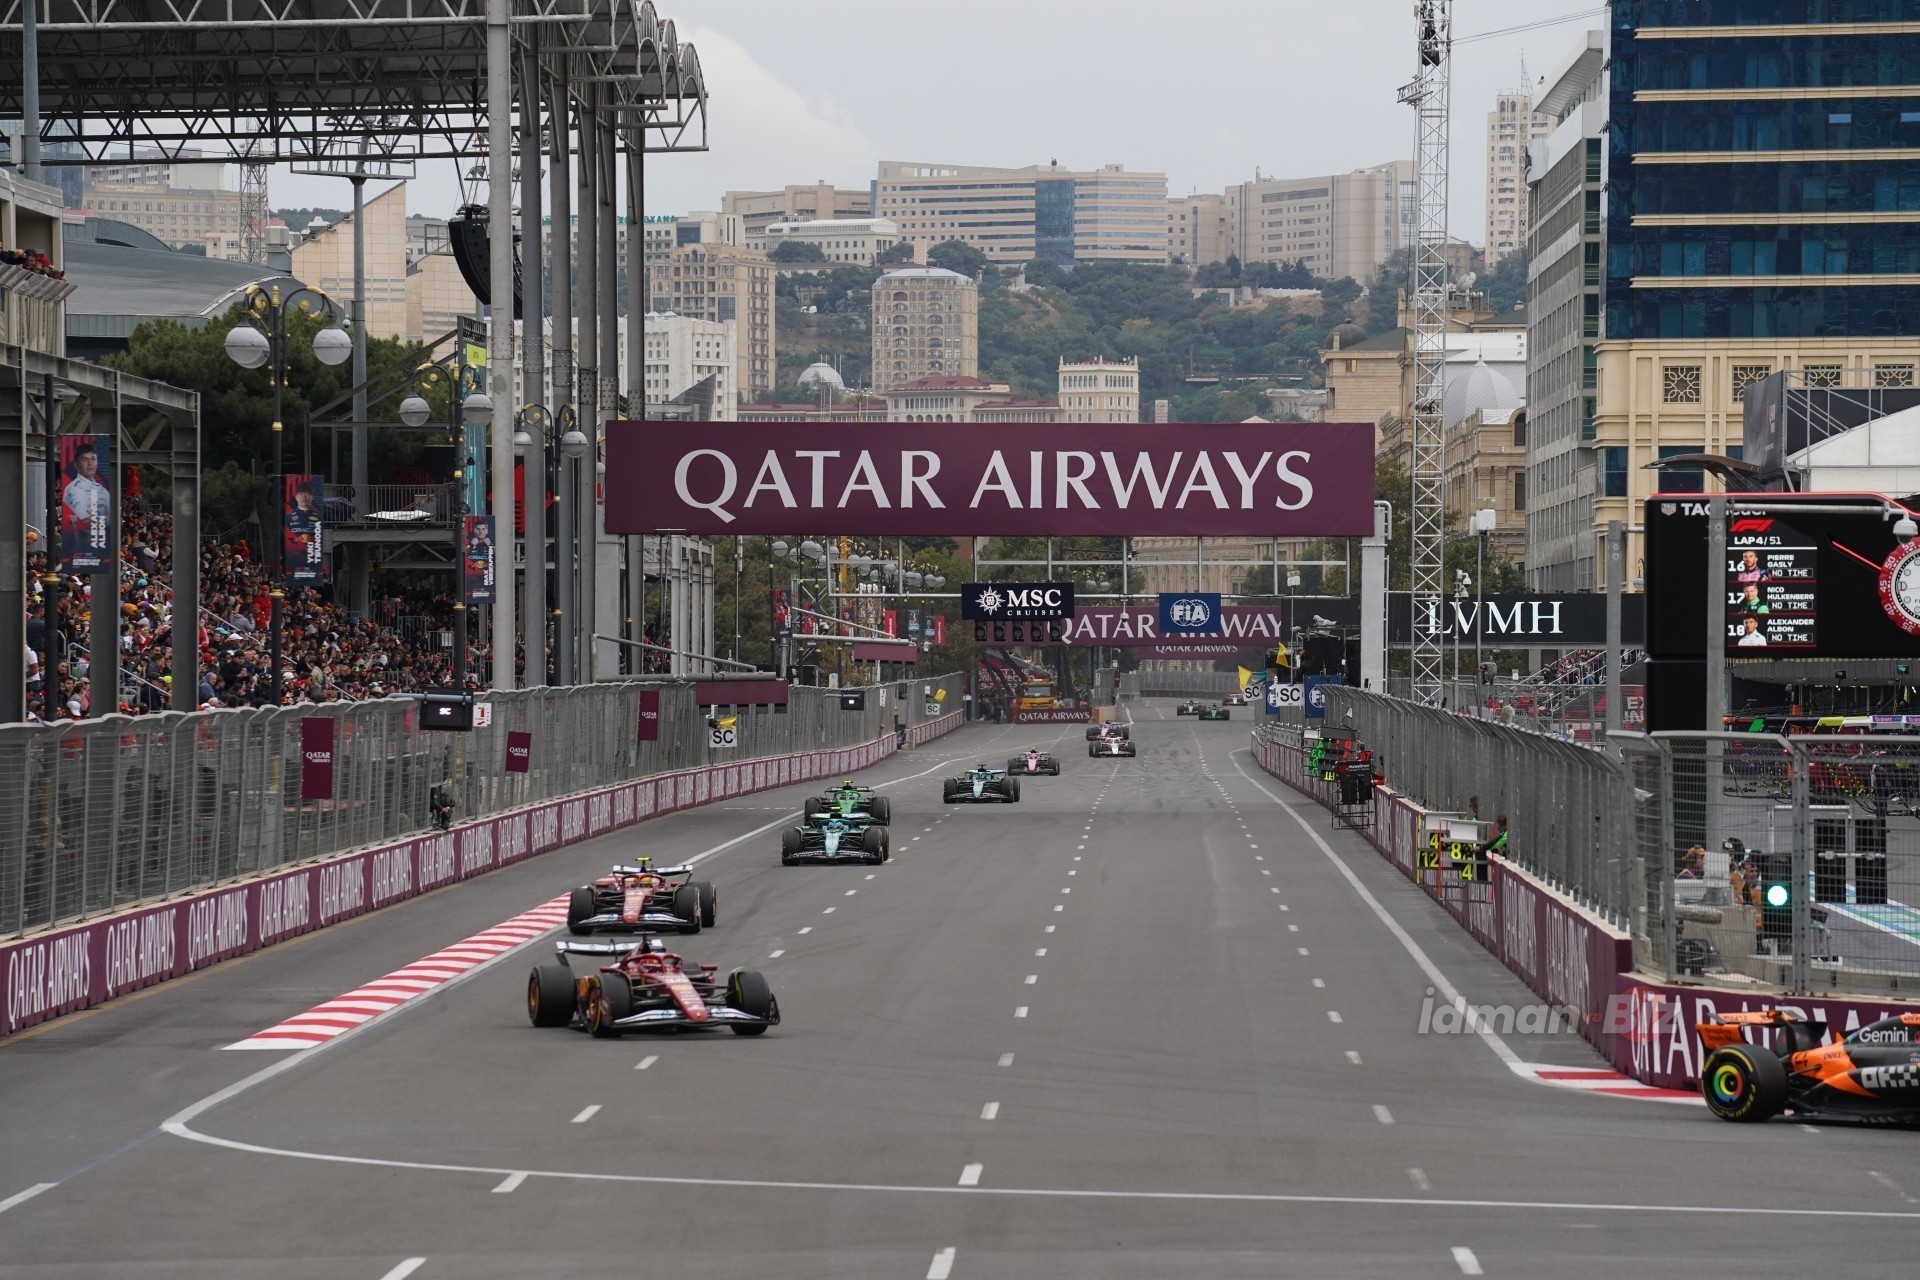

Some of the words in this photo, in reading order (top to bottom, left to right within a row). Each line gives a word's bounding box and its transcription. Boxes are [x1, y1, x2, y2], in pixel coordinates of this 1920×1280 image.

[674, 449, 946, 523] QATAR
[968, 449, 1313, 510] AIRWAYS
[1734, 537, 1755, 545] LAP
[1728, 560, 1746, 572] 16
[1884, 556, 1896, 569] 50
[1772, 569, 1783, 577] NO
[1787, 569, 1808, 577] TIME
[1880, 580, 1888, 593] 45
[1006, 589, 1062, 607] MSC
[1728, 592, 1746, 604] 17
[1772, 601, 1783, 609] NO
[1787, 601, 1808, 609] TIME
[1884, 603, 1895, 616] 40
[1425, 601, 1564, 635] LVMH
[1728, 624, 1746, 636] 18
[1901, 622, 1915, 633] 35
[1772, 633, 1783, 641] NO
[1787, 633, 1808, 641] TIME
[1245, 686, 1260, 699] SC
[1280, 688, 1301, 702] SC
[927, 705, 938, 713] SC
[1019, 712, 1049, 721] QATAR
[1051, 711, 1090, 720] AIRWAYS
[713, 730, 734, 744] SC
[1429, 833, 1439, 849] 4
[1421, 851, 1439, 867] 12
[1462, 863, 1472, 880] 4
[106, 919, 137, 996] QATAR
[8, 943, 45, 1029] QATAR
[46, 930, 90, 1009] AIRWAYS
[1859, 1027, 1908, 1043] Gemini
[1861, 1065, 1919, 1088] OKX
